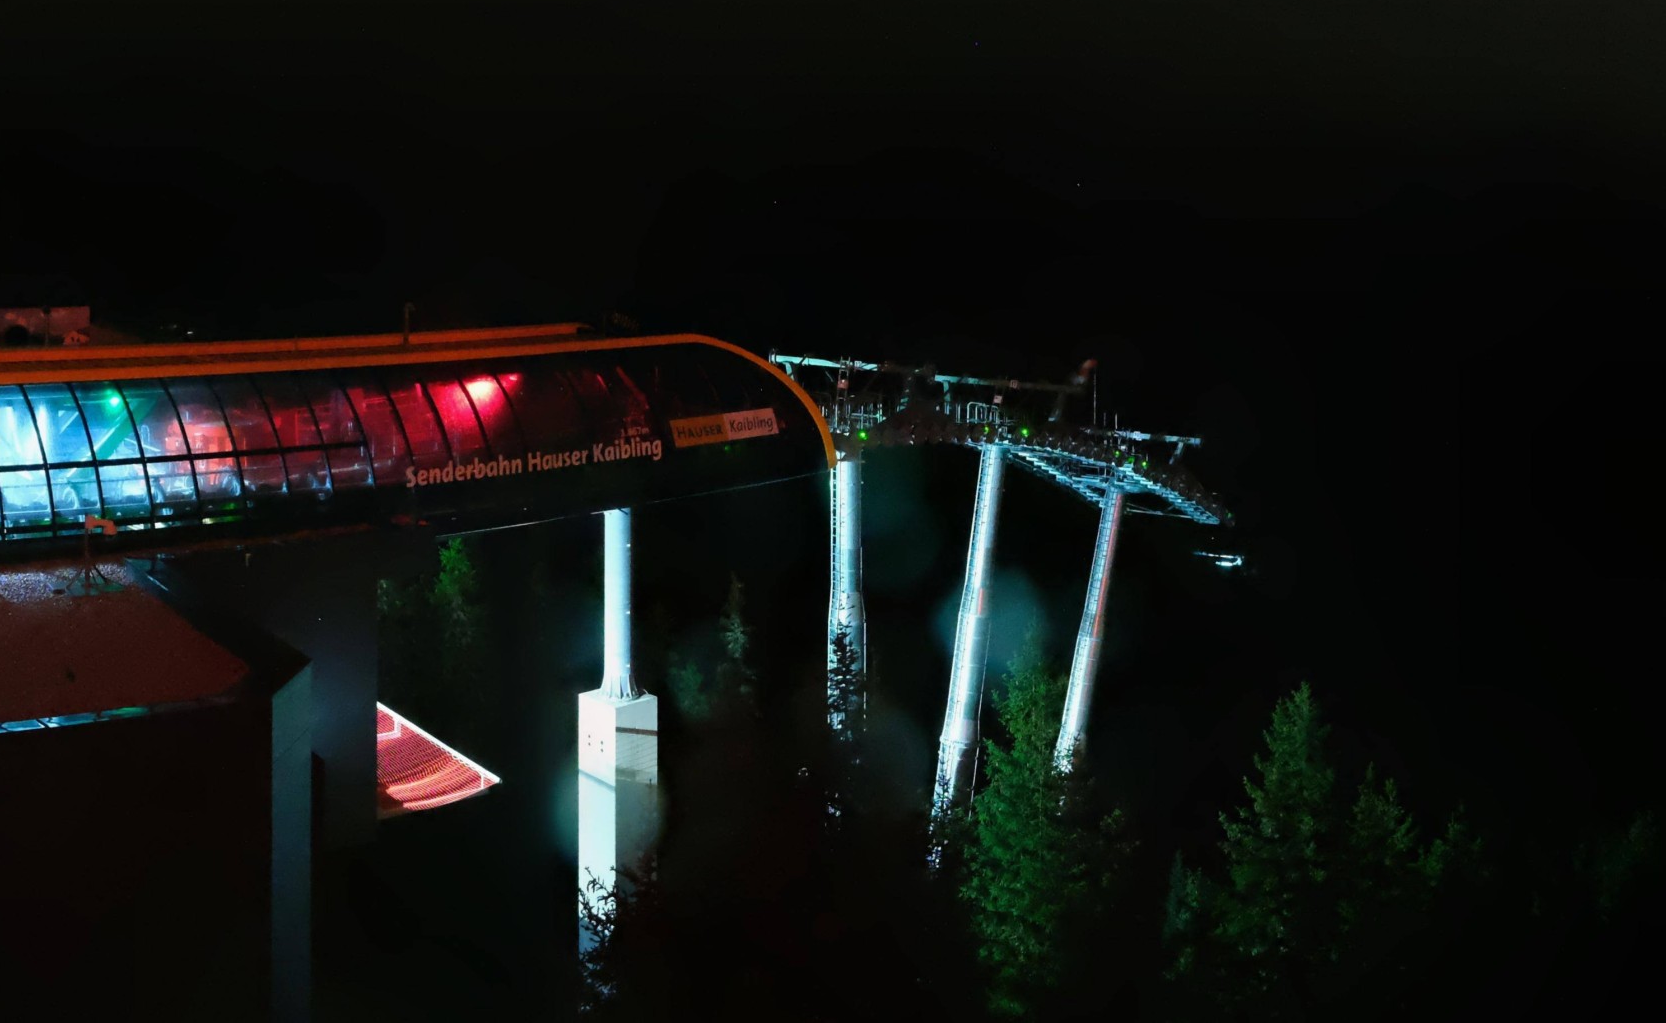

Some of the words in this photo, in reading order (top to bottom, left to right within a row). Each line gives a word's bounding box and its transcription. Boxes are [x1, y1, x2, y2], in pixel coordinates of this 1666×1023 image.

[676, 424, 723, 439] HAUSER
[729, 417, 774, 433] Kaibling
[405, 454, 522, 488] Senderbahn
[527, 450, 589, 472] Hauser
[592, 437, 662, 462] Kaibling
